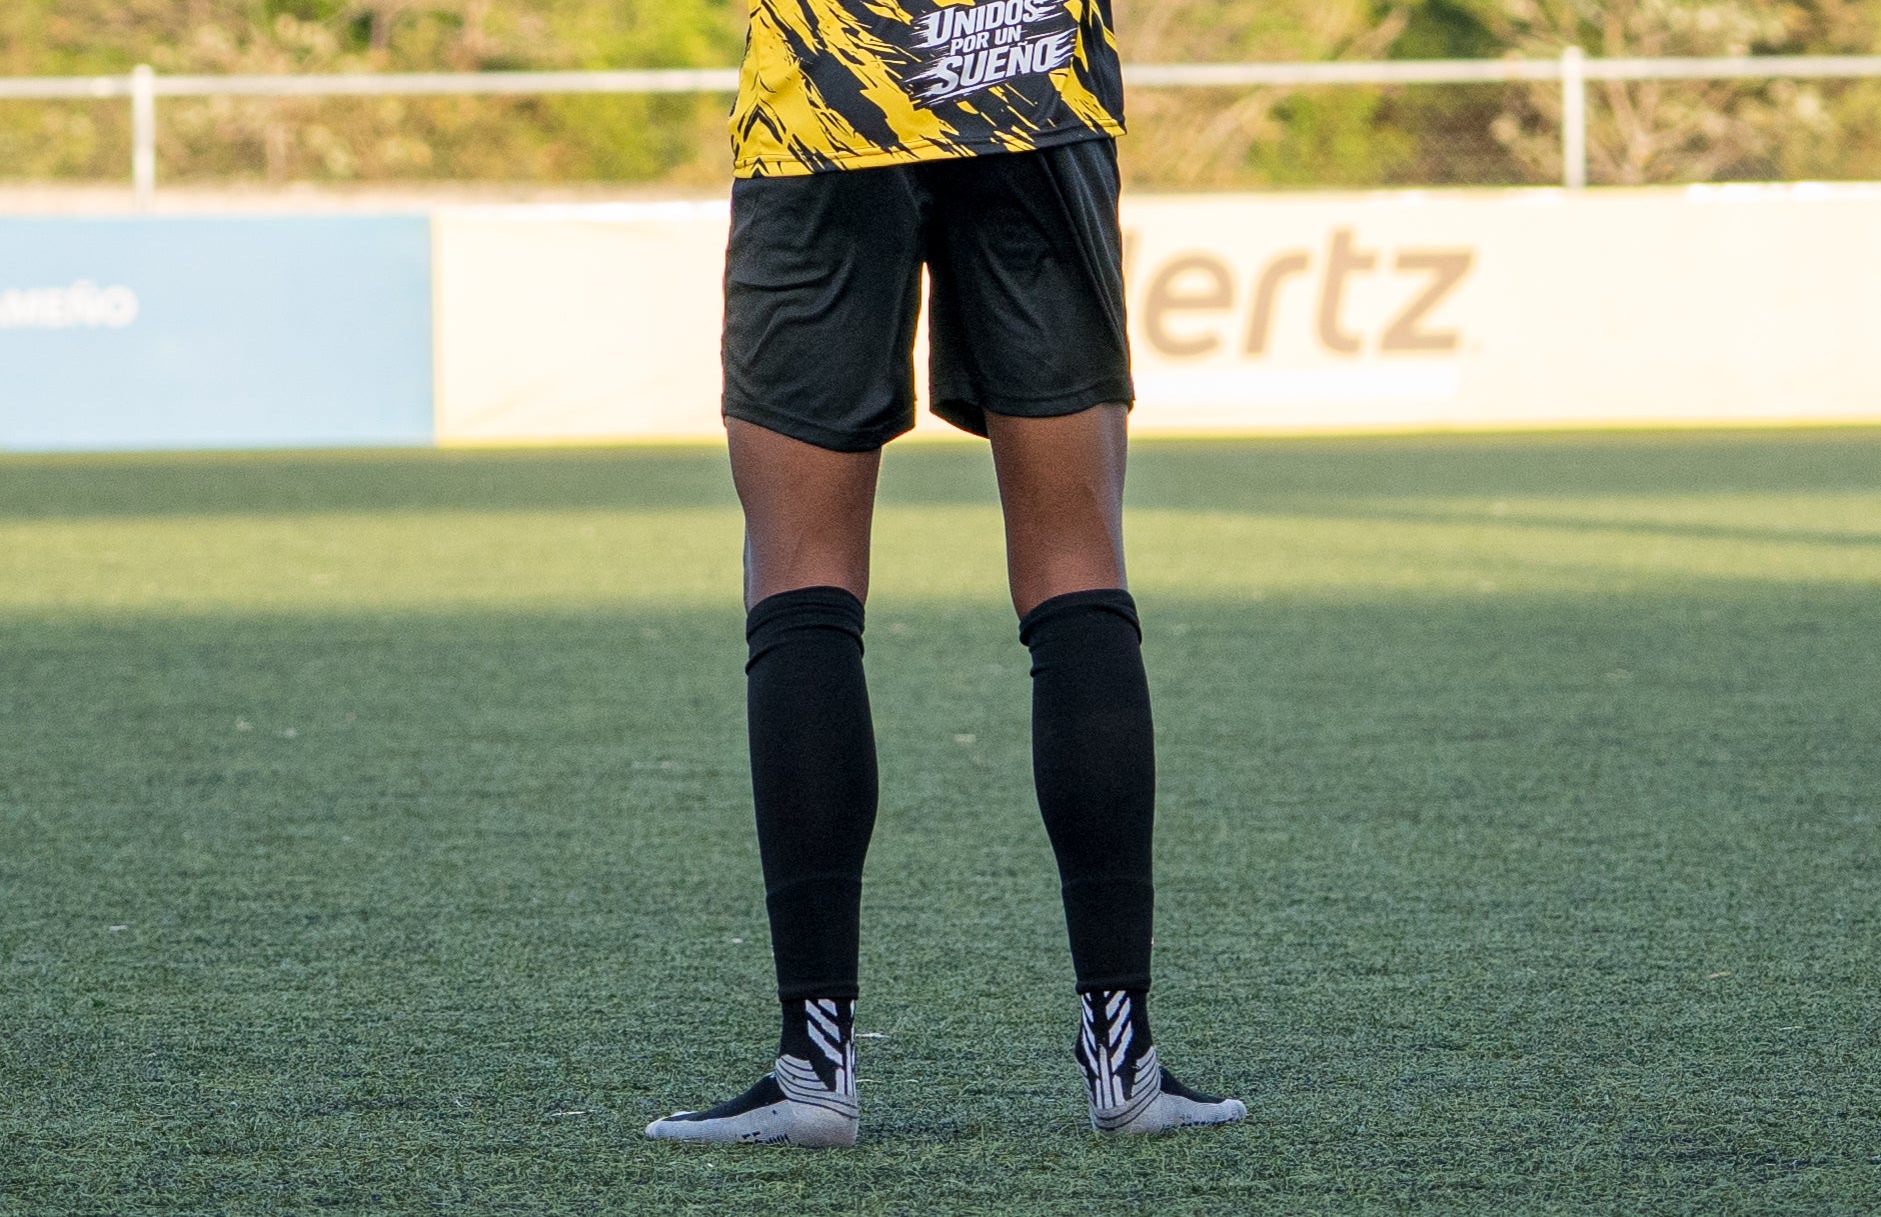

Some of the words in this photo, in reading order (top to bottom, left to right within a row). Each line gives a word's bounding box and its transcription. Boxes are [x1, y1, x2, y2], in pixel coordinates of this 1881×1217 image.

[926, 36, 1066, 98] SUEÑO
[950, 32, 989, 56] POR
[994, 25, 1022, 44] UN
[1122, 226, 1478, 357] ertz
